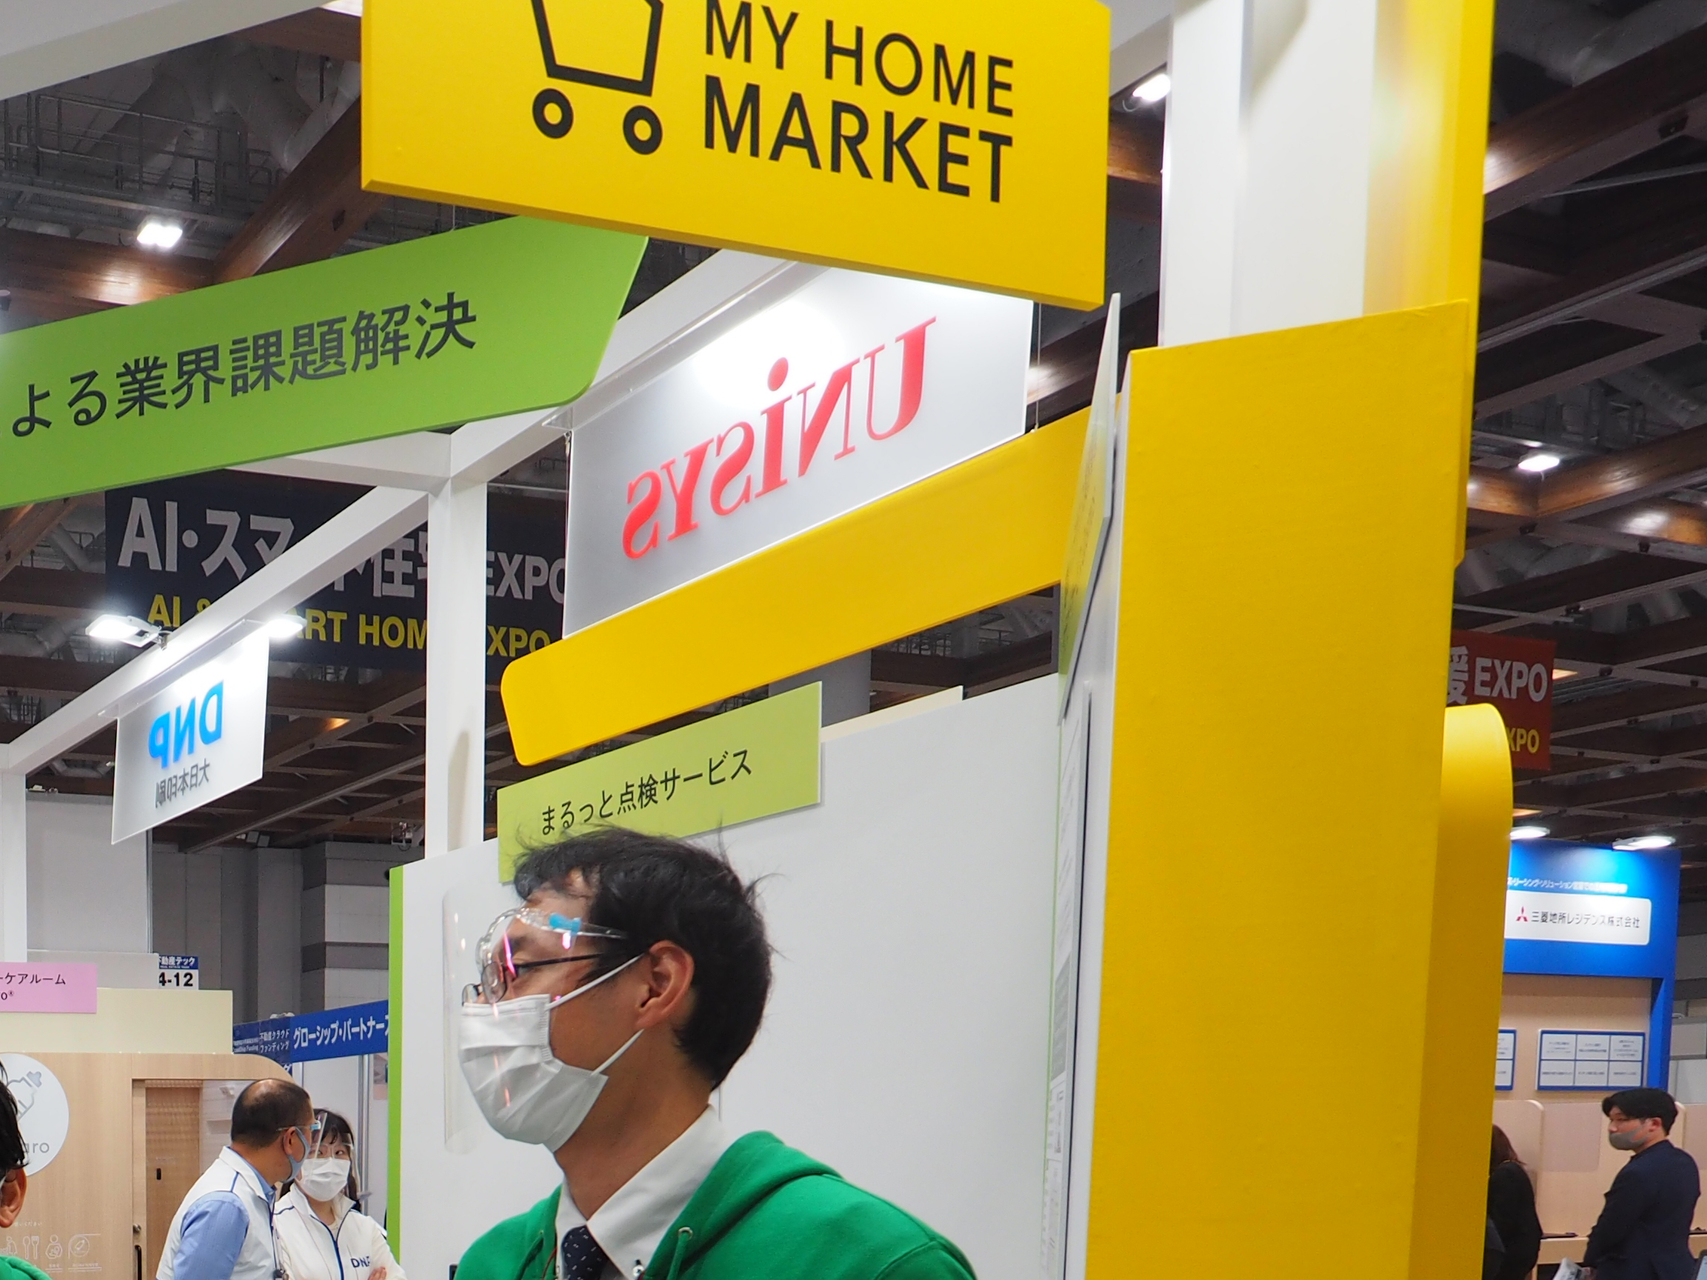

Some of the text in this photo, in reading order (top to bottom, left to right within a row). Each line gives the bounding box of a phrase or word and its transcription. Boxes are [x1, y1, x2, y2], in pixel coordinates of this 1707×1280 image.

[705, 0, 1014, 118] MY HOME
[704, 73, 1014, 204] MARKET
[147, 593, 182, 628] AI
[358, 613, 427, 650] HOM
[486, 624, 551, 657] XPO
[1506, 726, 1540, 754] XPO
[541, 748, 753, 836] まるっと点検サービス
